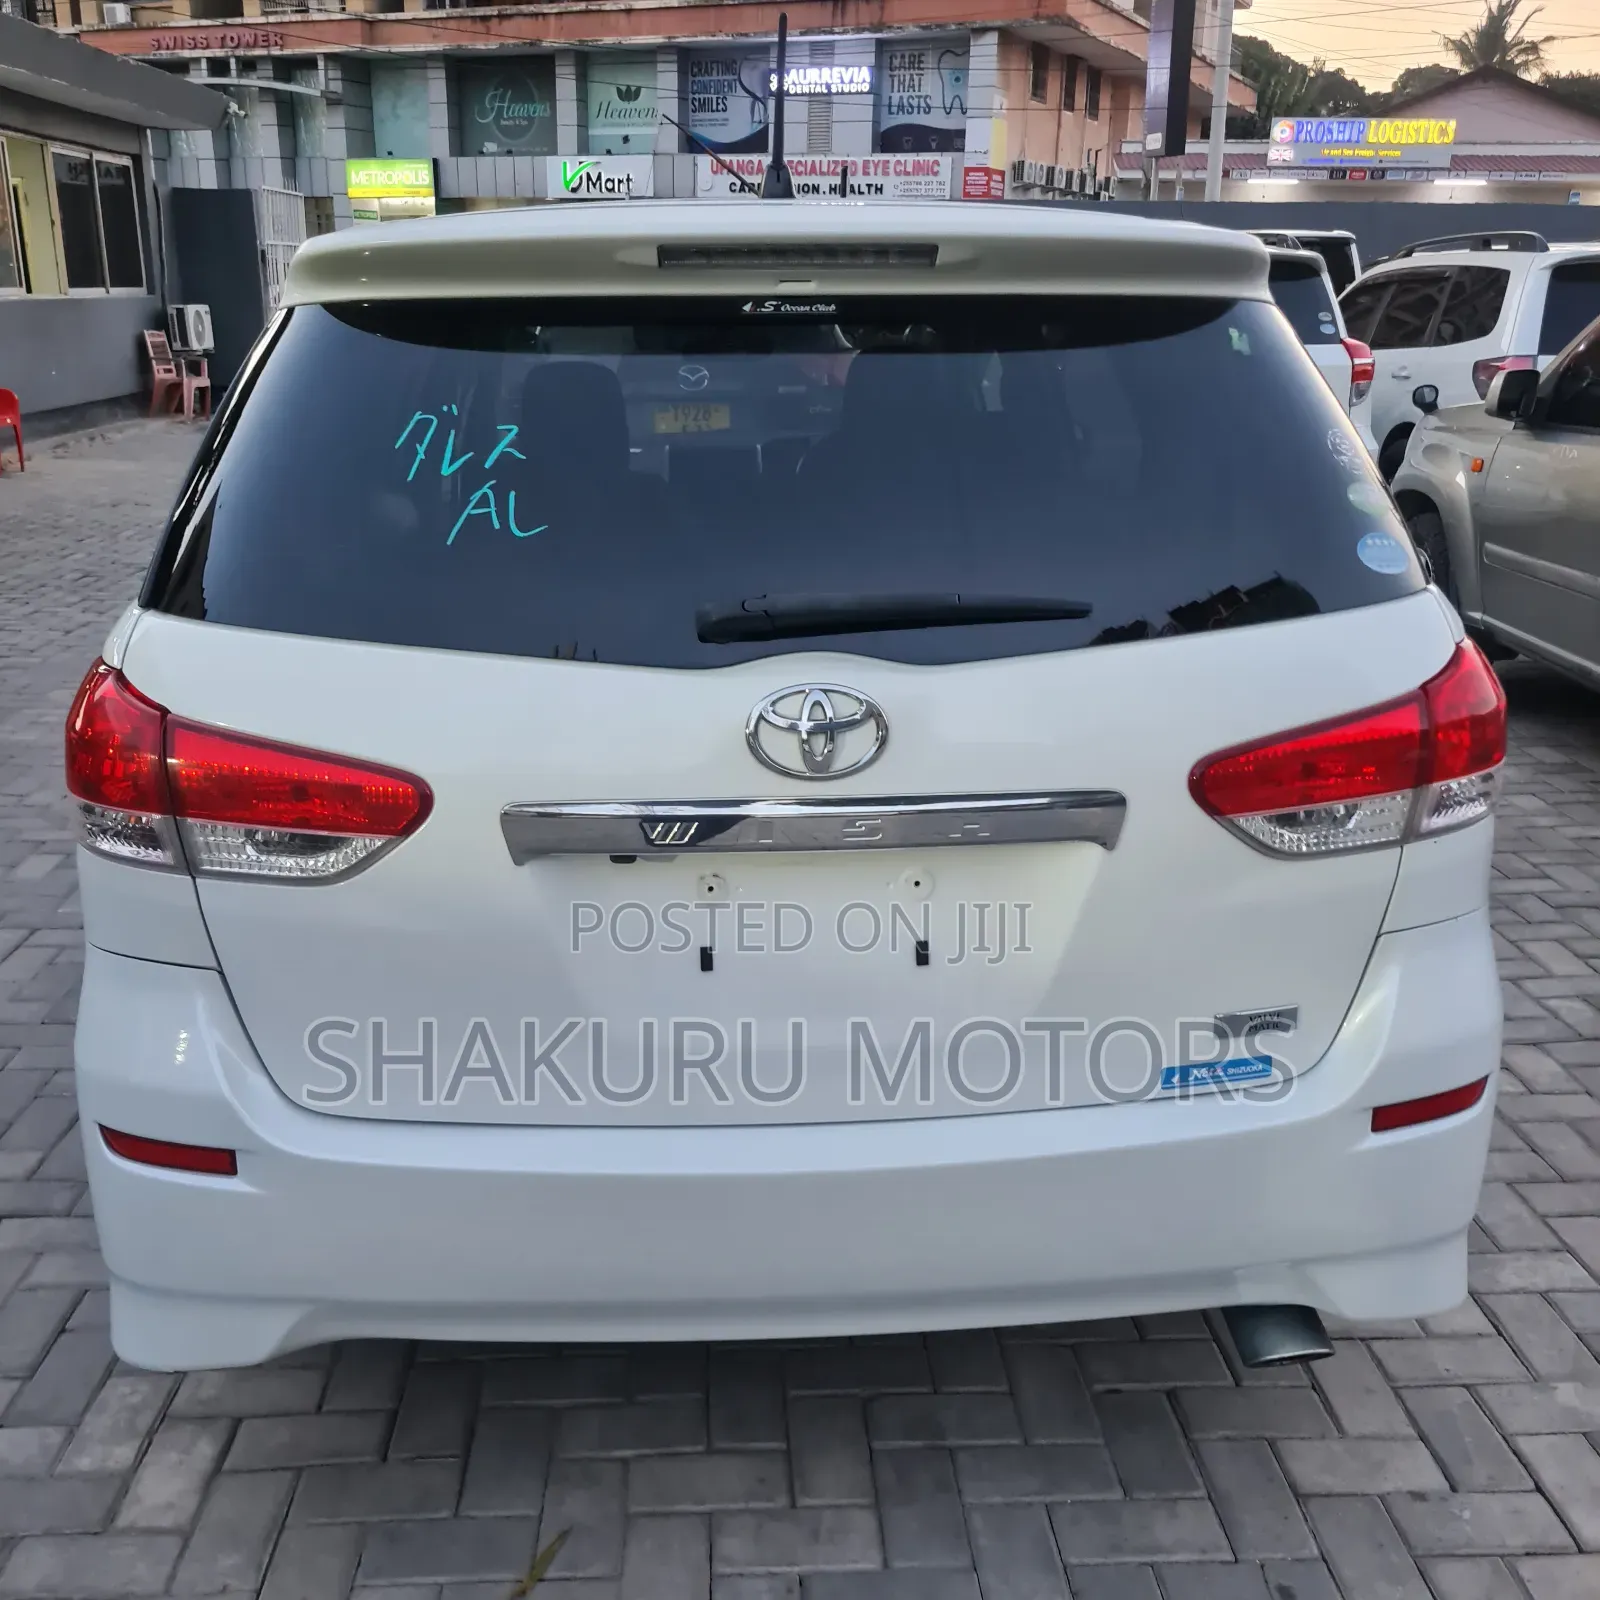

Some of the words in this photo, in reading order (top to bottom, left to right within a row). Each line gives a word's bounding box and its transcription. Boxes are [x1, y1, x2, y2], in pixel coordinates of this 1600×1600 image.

[150, 35, 208, 51] SWISS
[213, 31, 284, 49] TOWER
[690, 59, 738, 77] CRAFTING
[889, 52, 926, 72] CARE
[690, 78, 738, 95] CONFIDENT
[789, 84, 828, 94] DENTAL
[831, 82, 870, 93] STUDIO
[889, 73, 925, 93] THAT
[475, 87, 551, 123] Heavens
[690, 96, 728, 113] SMILES
[887, 95, 932, 116] LASTS
[1294, 119, 1366, 144] PROSHIP
[1367, 119, 1457, 144] LOGISTICS
[351, 169, 430, 186] METROPOLIS
[710, 159, 765, 176] UPANGA
[786, 159, 858, 176] ECIALIZD
[862, 159, 891, 176] EYE
[893, 159, 941, 177] CLINIC
[586, 171, 632, 195] Mart
[446, 479, 549, 546] AL
